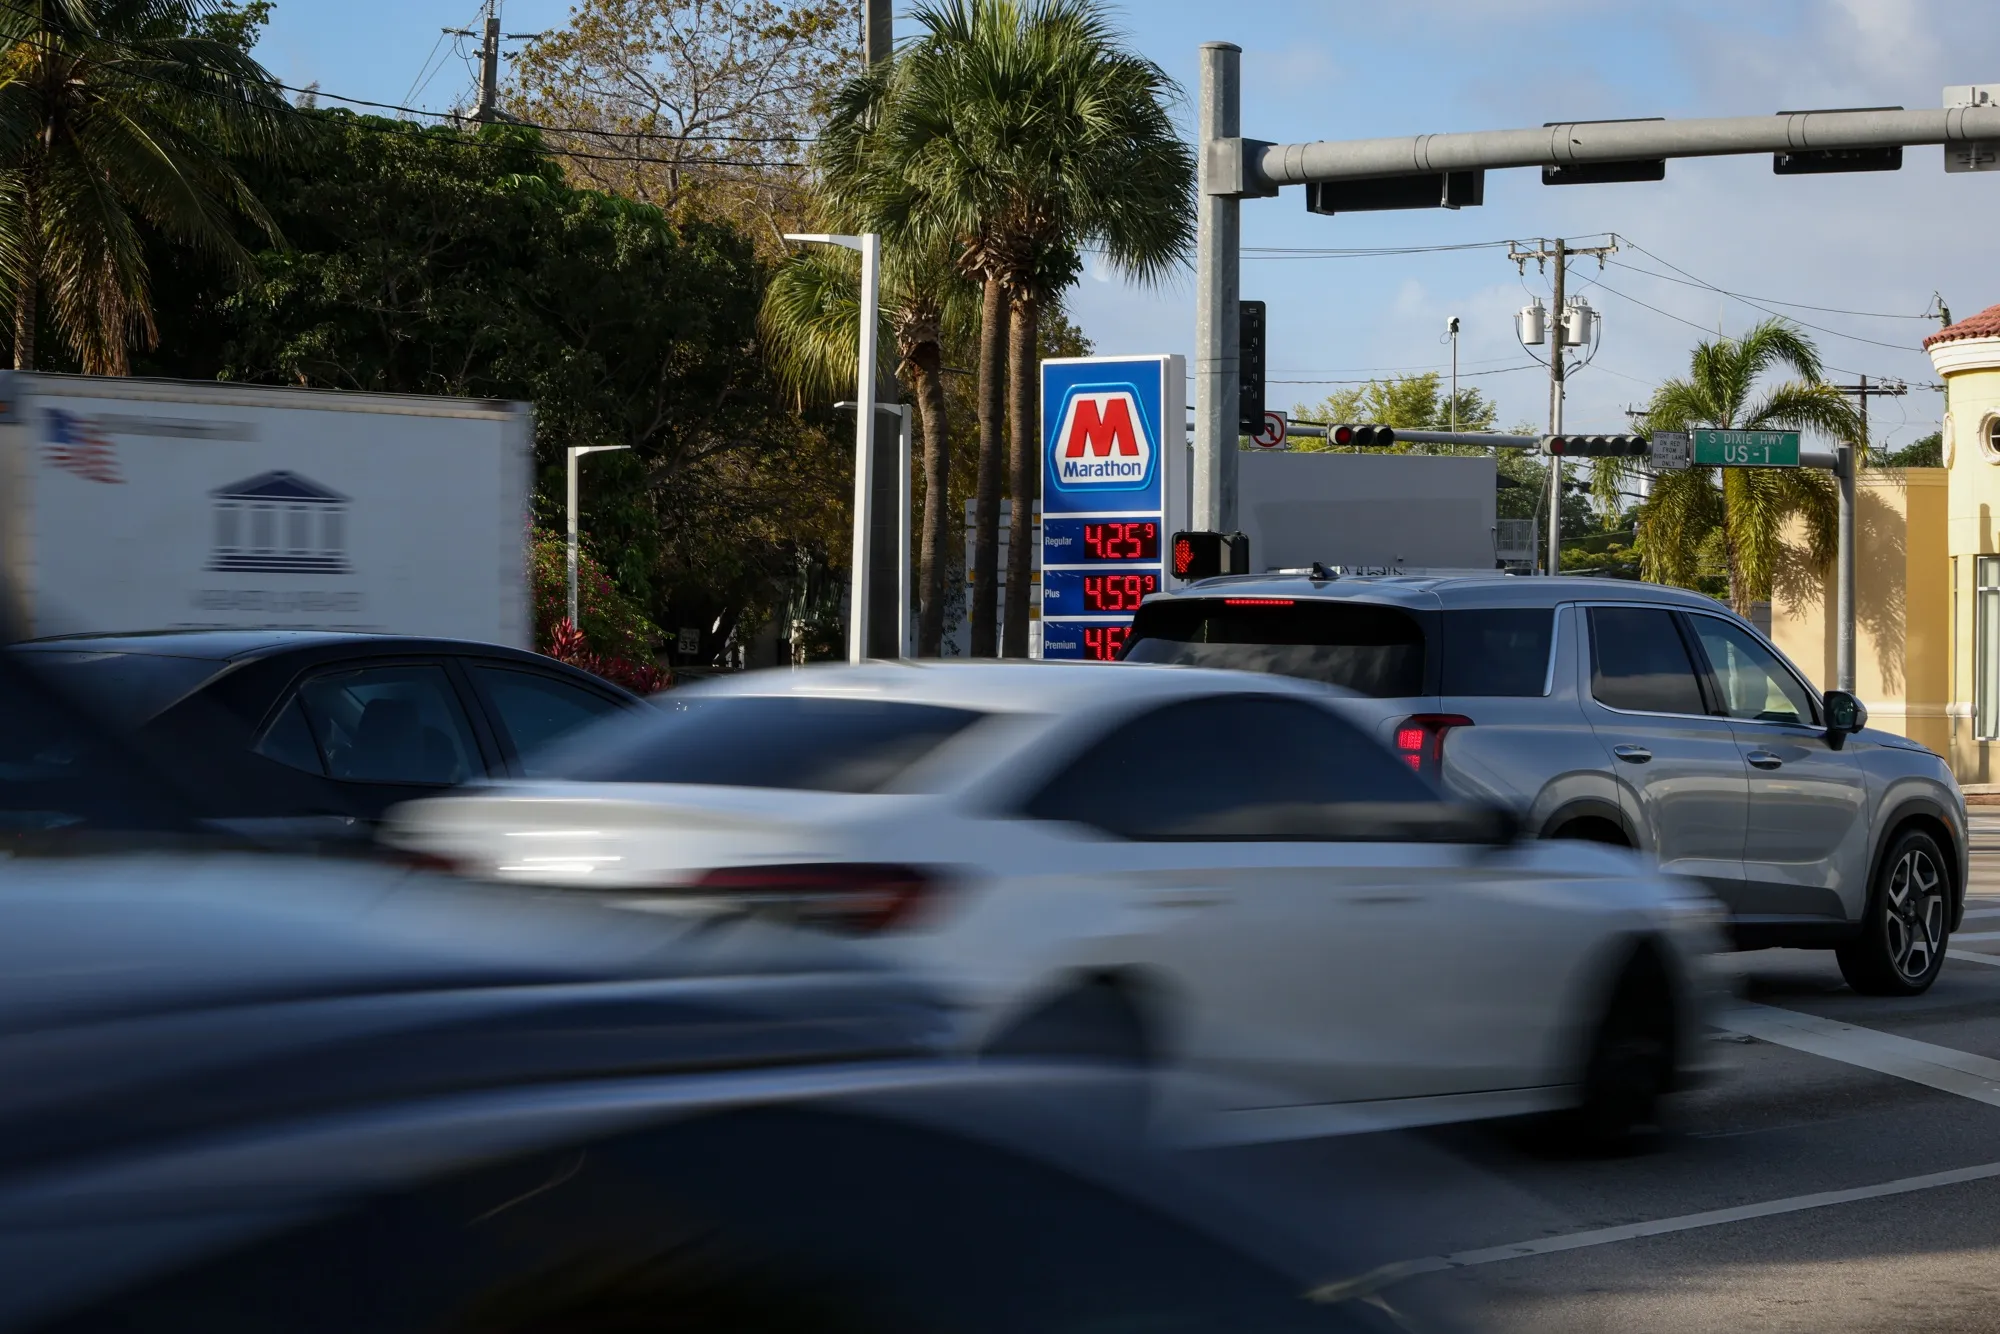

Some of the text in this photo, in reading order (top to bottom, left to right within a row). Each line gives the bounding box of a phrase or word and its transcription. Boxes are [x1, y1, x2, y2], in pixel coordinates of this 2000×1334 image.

[1065, 398, 1139, 458] M
[1709, 433, 1784, 445] S DIXIE HWY
[1063, 461, 1142, 478] Marathon
[1045, 536, 1073, 548] Regular
[1045, 588, 1060, 598] Plus
[681, 640, 697, 651] 35
[1045, 640, 1077, 650] Premium
